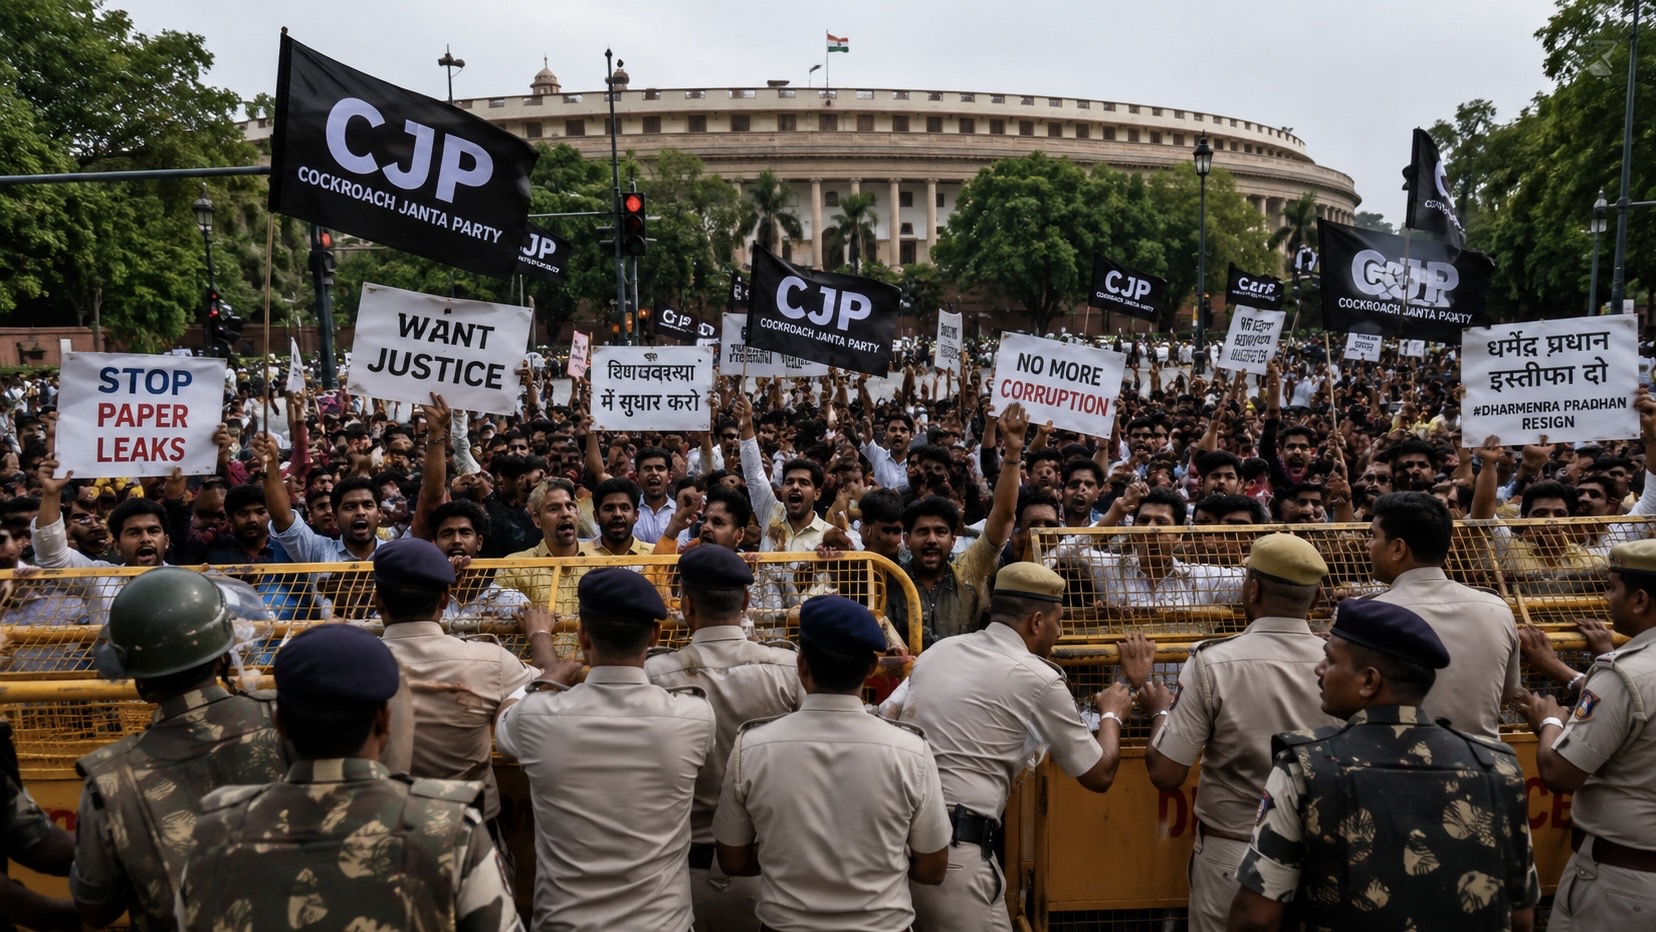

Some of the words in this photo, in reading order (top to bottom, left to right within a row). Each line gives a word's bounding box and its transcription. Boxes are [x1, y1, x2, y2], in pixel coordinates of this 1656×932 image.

[326, 97, 494, 203] CJP
[298, 166, 396, 210] COCKROACH
[399, 200, 447, 228] JANTA
[452, 217, 503, 244] PARTY
[520, 233, 557, 259] JP
[1105, 270, 1151, 300] CJP
[776, 276, 872, 331] CJP
[1338, 297, 1400, 315] COCKROACH
[398, 313, 495, 349] WANT
[760, 318, 815, 339] COCKROACH
[816, 331, 846, 347] JANTA
[848, 338, 880, 353] PARTY
[98, 367, 192, 395] STOP
[367, 348, 505, 390] JUSTICE
[1016, 353, 1044, 375] NO
[1049, 359, 1103, 387] MORE
[1488, 361, 1575, 392] इस्तीफा
[1582, 357, 1608, 385] दो
[601, 389, 615, 411] में
[619, 394, 662, 417] सुधार
[667, 389, 700, 411] करो
[1001, 379, 1109, 417] CORRUPTION
[1473, 401, 1560, 416] #DHARMENRA
[1564, 397, 1627, 412] PRADHAN
[97, 403, 189, 428] PAPER
[1522, 416, 1575, 430] RESIGN
[97, 437, 186, 462] LEAKS
